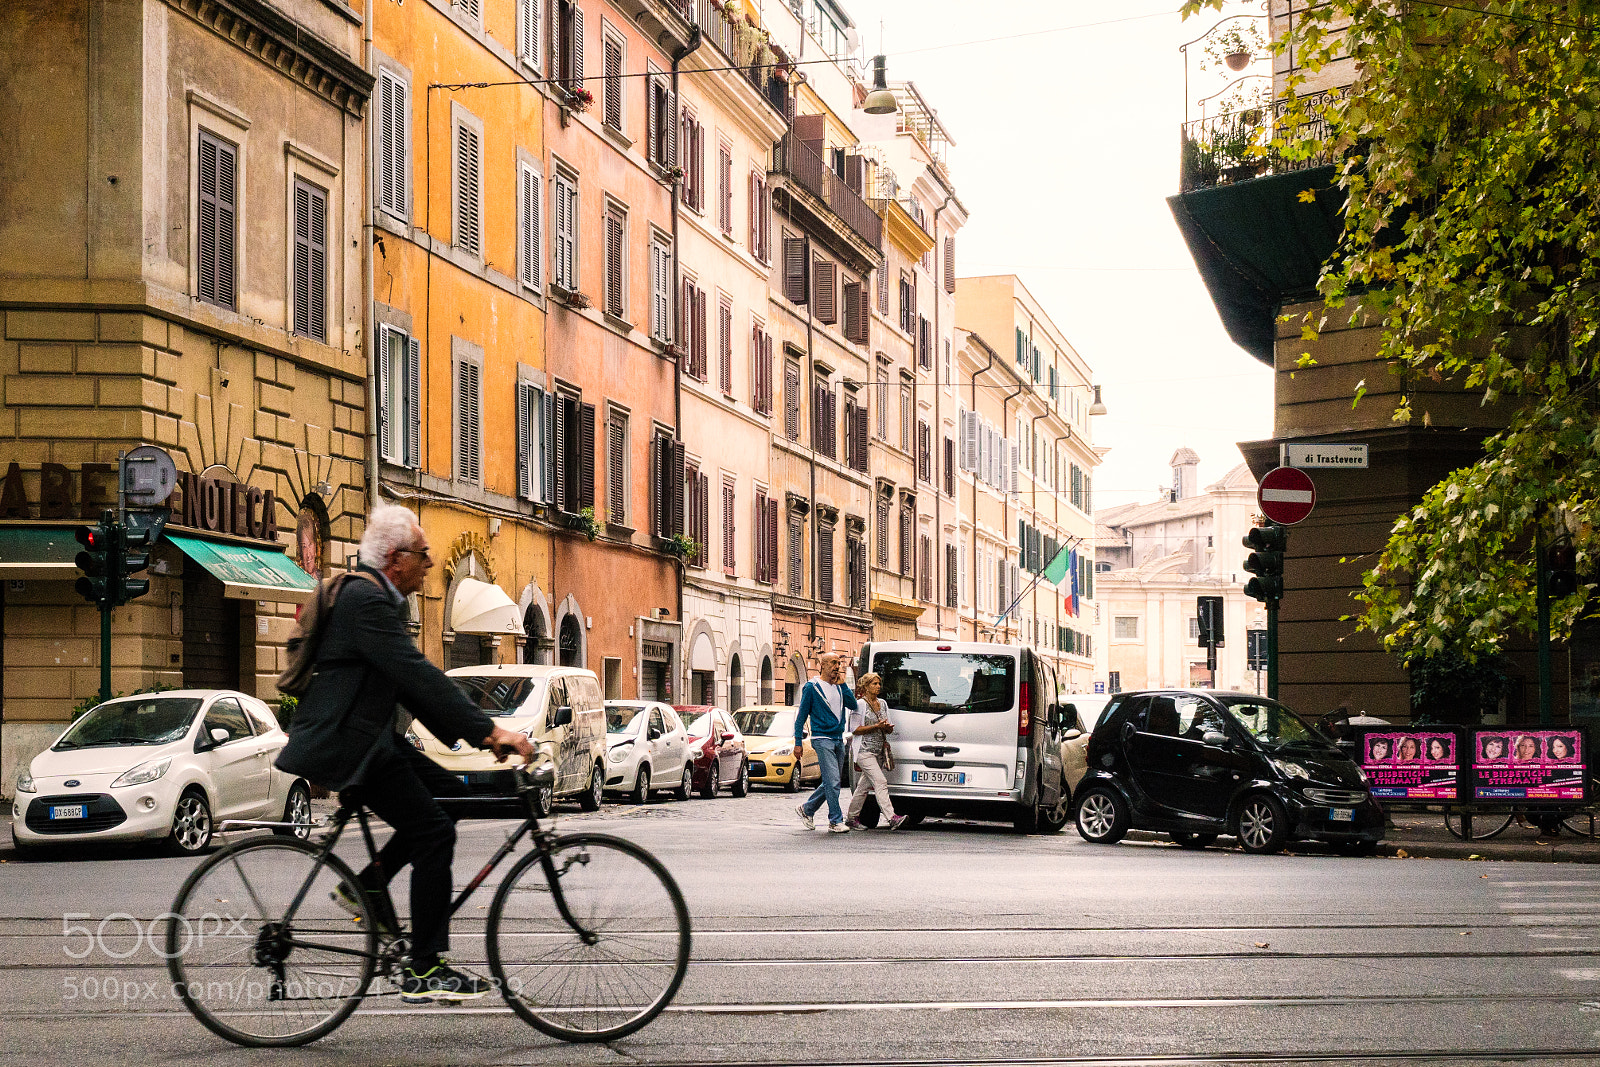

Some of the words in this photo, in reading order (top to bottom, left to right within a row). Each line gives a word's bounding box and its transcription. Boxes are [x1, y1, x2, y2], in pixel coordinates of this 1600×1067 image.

[1305, 454, 1314, 464] di
[1316, 454, 1363, 464] Trastevere
[167, 471, 278, 541] ENOTECA
[917, 772, 929, 781] ED
[1492, 770, 1552, 778] BISBETICHE
